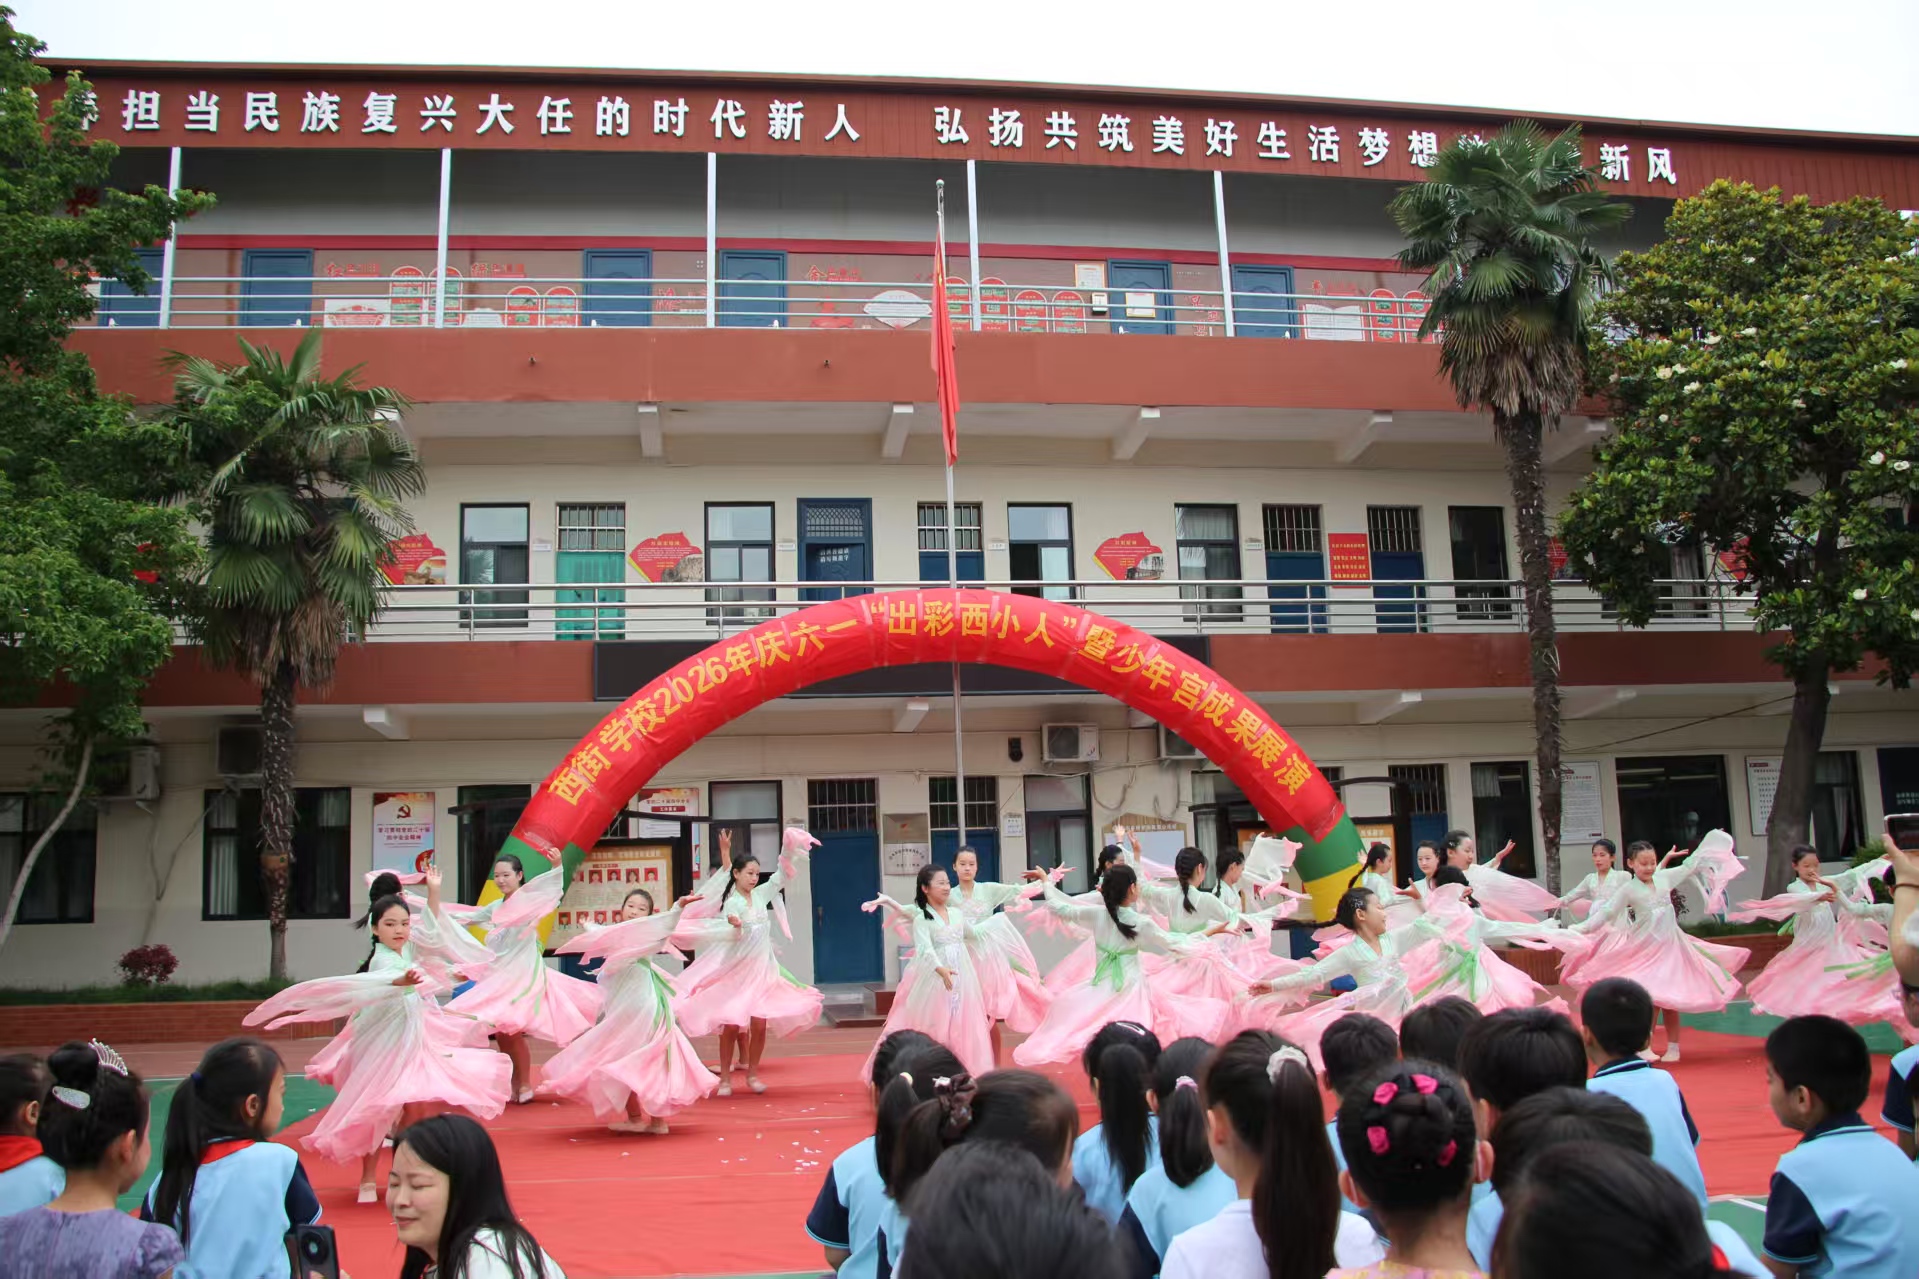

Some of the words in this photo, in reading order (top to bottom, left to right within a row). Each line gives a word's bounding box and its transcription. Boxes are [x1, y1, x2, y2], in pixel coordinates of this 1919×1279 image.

[2, 87, 861, 143] 担当民族复兴大任的时代新人
[934, 105, 1677, 185] 弘扬共筑美好生活梦想新风
